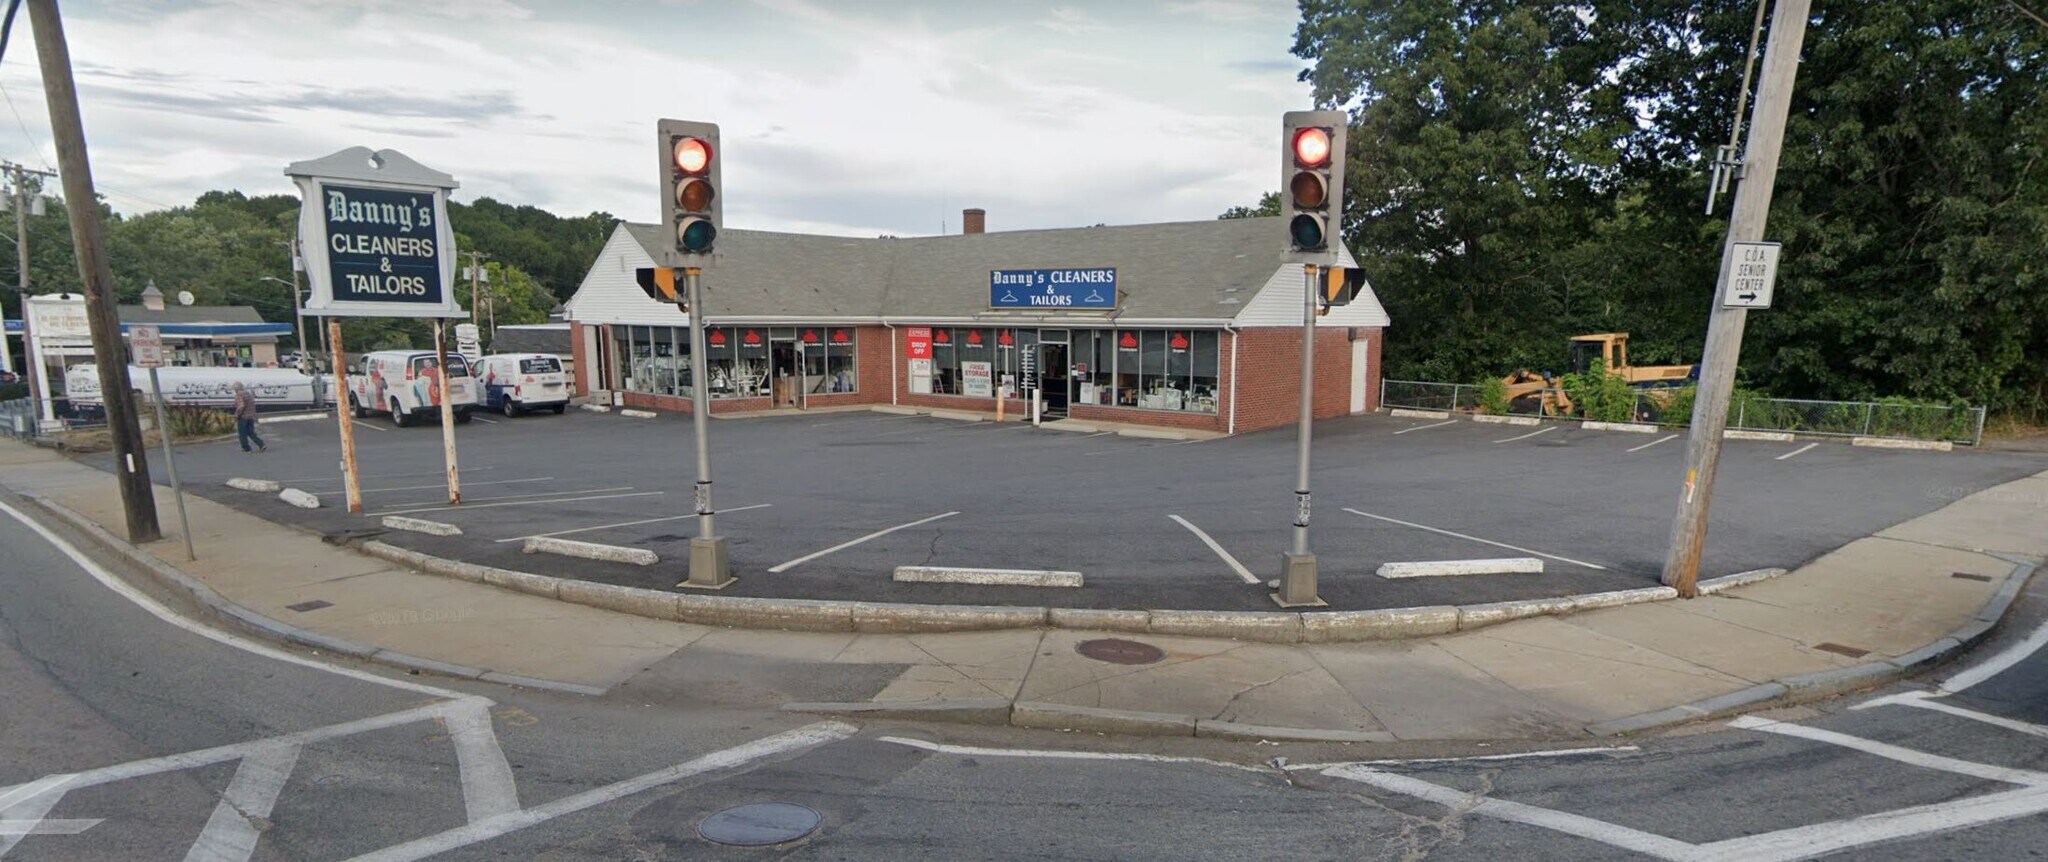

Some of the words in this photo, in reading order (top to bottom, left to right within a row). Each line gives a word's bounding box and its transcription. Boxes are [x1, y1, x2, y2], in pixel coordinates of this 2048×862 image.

[327, 190, 432, 233] Danny's
[331, 233, 435, 258] CLEANERS
[380, 256, 392, 272] &
[1738, 264, 1767, 277] SENIOR
[346, 274, 426, 296] TAILORS
[993, 271, 1045, 287] Danny's
[1050, 270, 1114, 283] CLEANERS
[1735, 278, 1764, 291] CENTER
[1046, 284, 1055, 294] &
[1029, 295, 1072, 305] TAILORS
